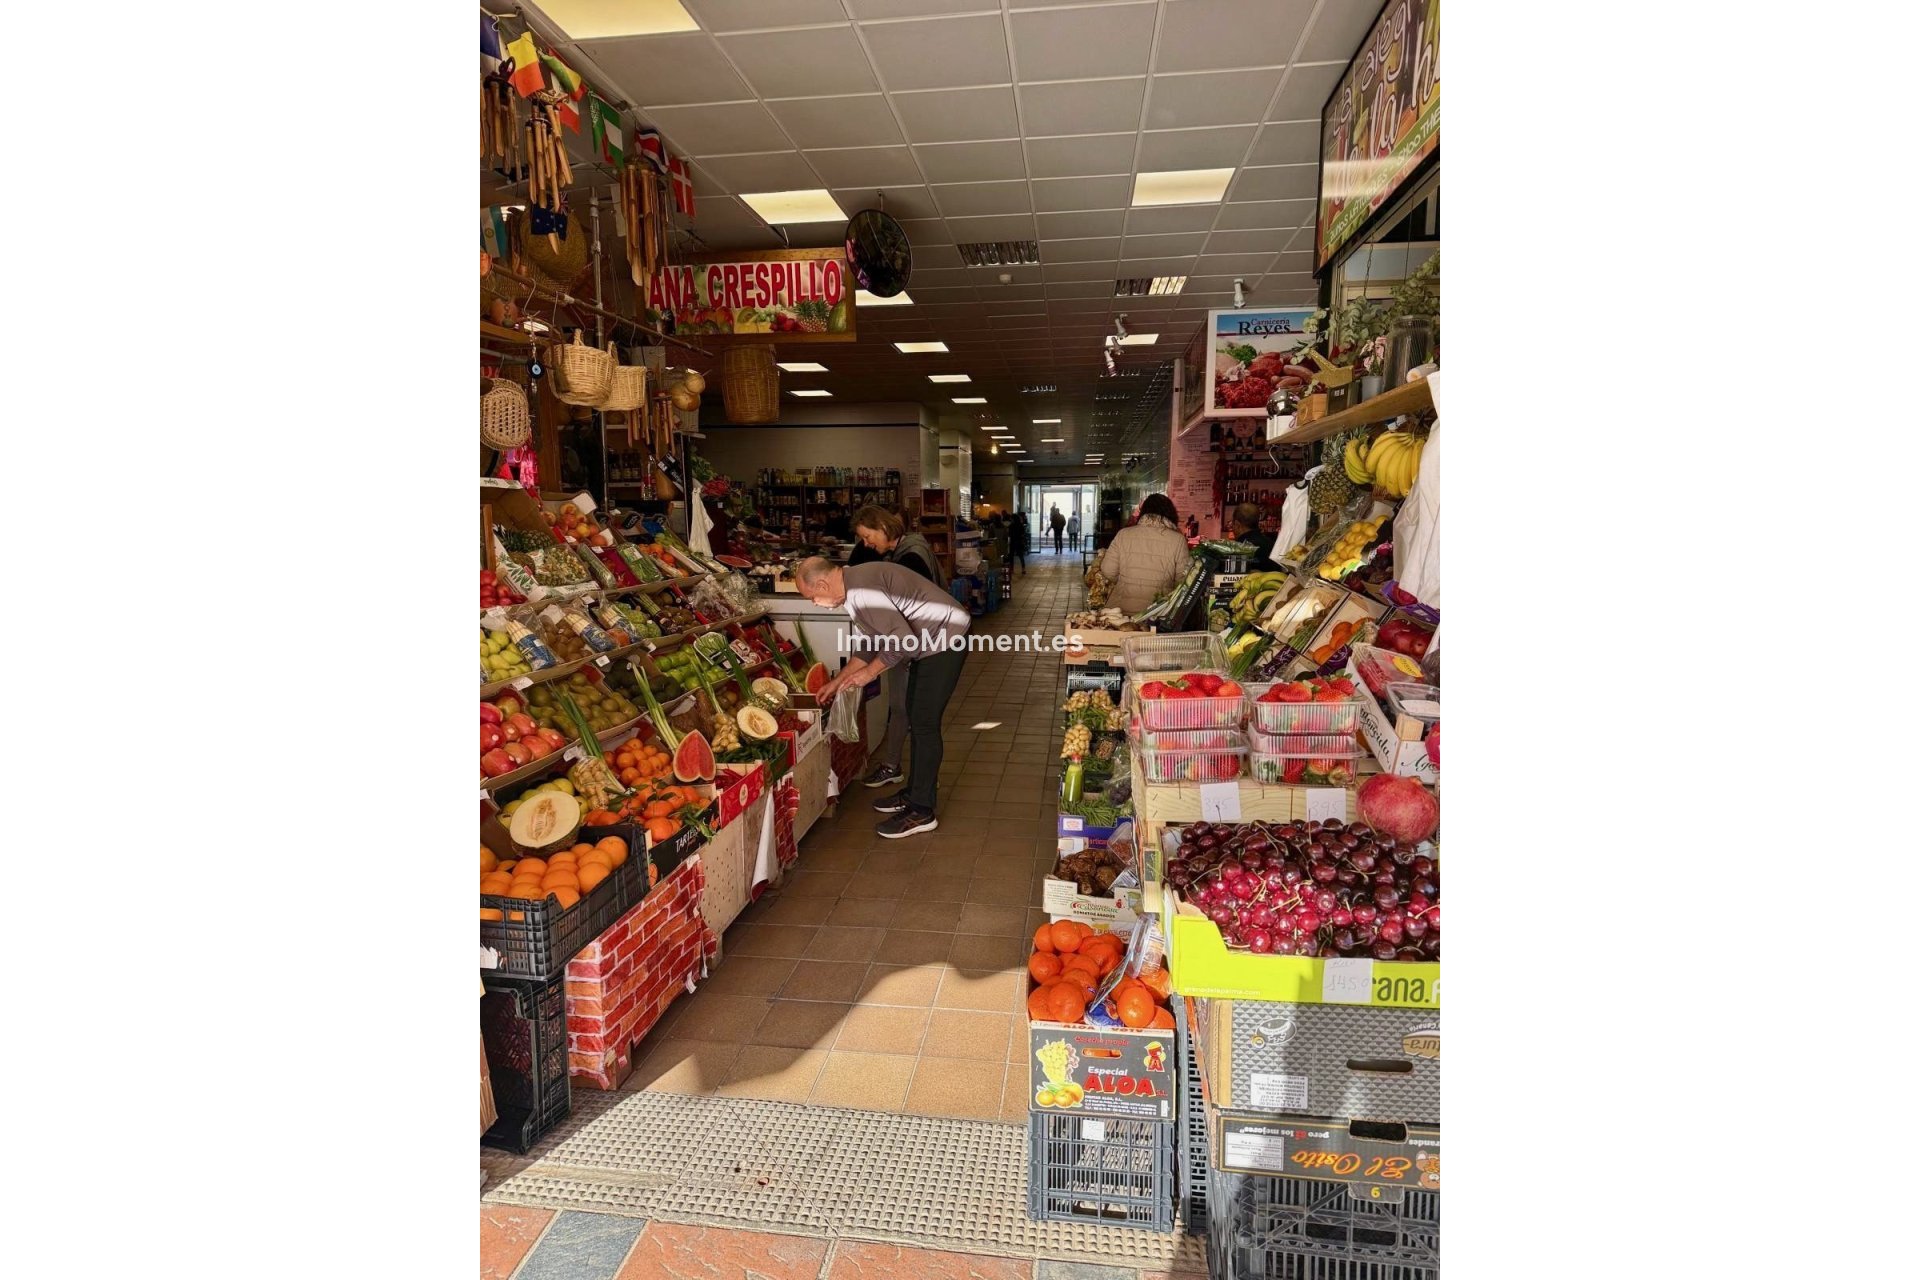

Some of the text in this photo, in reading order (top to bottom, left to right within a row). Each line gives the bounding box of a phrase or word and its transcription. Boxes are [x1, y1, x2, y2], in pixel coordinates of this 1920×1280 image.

[1370, 81, 1405, 159] la
[650, 260, 841, 311] ANA CRESPILLO
[1238, 321, 1291, 339] Reyes
[1088, 1066, 1128, 1076] Especial
[1083, 1074, 1157, 1098] ALOA
[1280, 1129, 1294, 1138] los
[1307, 1129, 1330, 1139] pero
[1291, 1150, 1361, 1175] Osito
[1364, 1155, 1412, 1179] El
